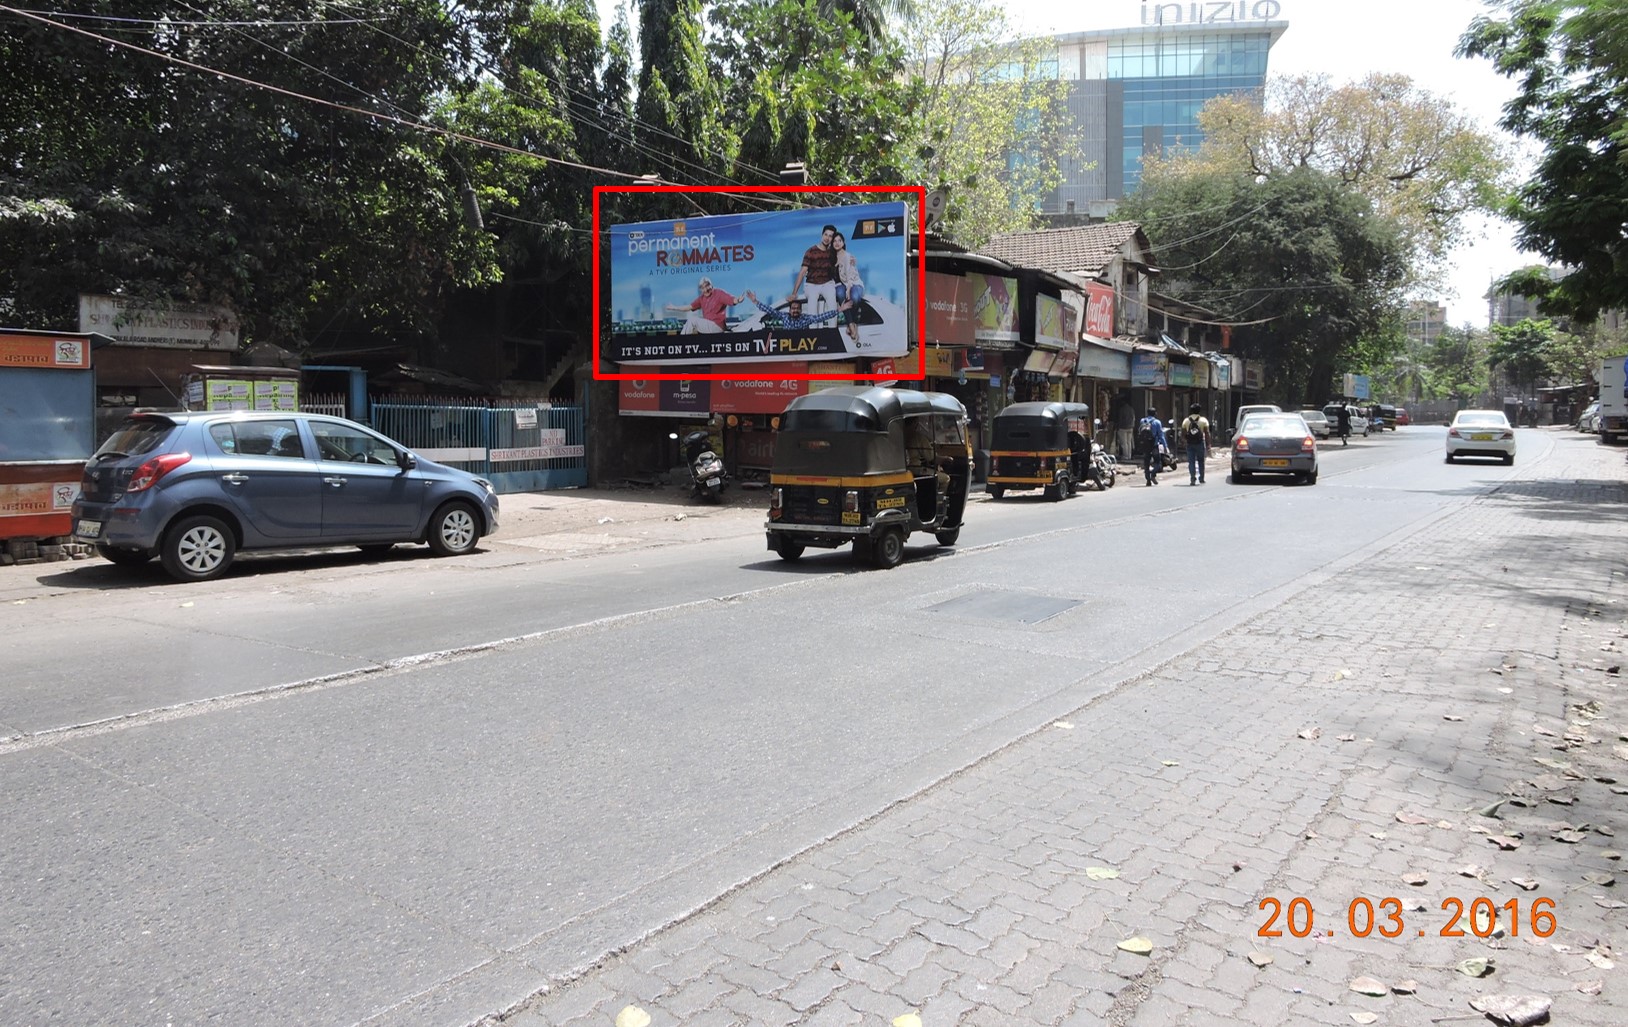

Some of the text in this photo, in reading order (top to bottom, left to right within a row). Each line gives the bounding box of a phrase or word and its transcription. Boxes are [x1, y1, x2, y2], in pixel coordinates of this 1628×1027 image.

[628, 232, 716, 256] permanent
[670, 266, 703, 275] ORIGINAL
[706, 264, 732, 273] SERIES
[930, 300, 957, 312] vodafone
[621, 347, 641, 357] IT'S
[644, 346, 665, 356] NOT
[668, 345, 682, 355] ON
[685, 344, 708, 354] TV...
[711, 343, 732, 353] IT'S
[735, 342, 750, 352] ON
[780, 337, 817, 353] PLAY
[734, 379, 773, 388] vodafone
[779, 379, 798, 390] 4G
[624, 391, 655, 399] vodafone
[491, 446, 584, 460] SHRIKANT PLASTICS INDUSTRIES
